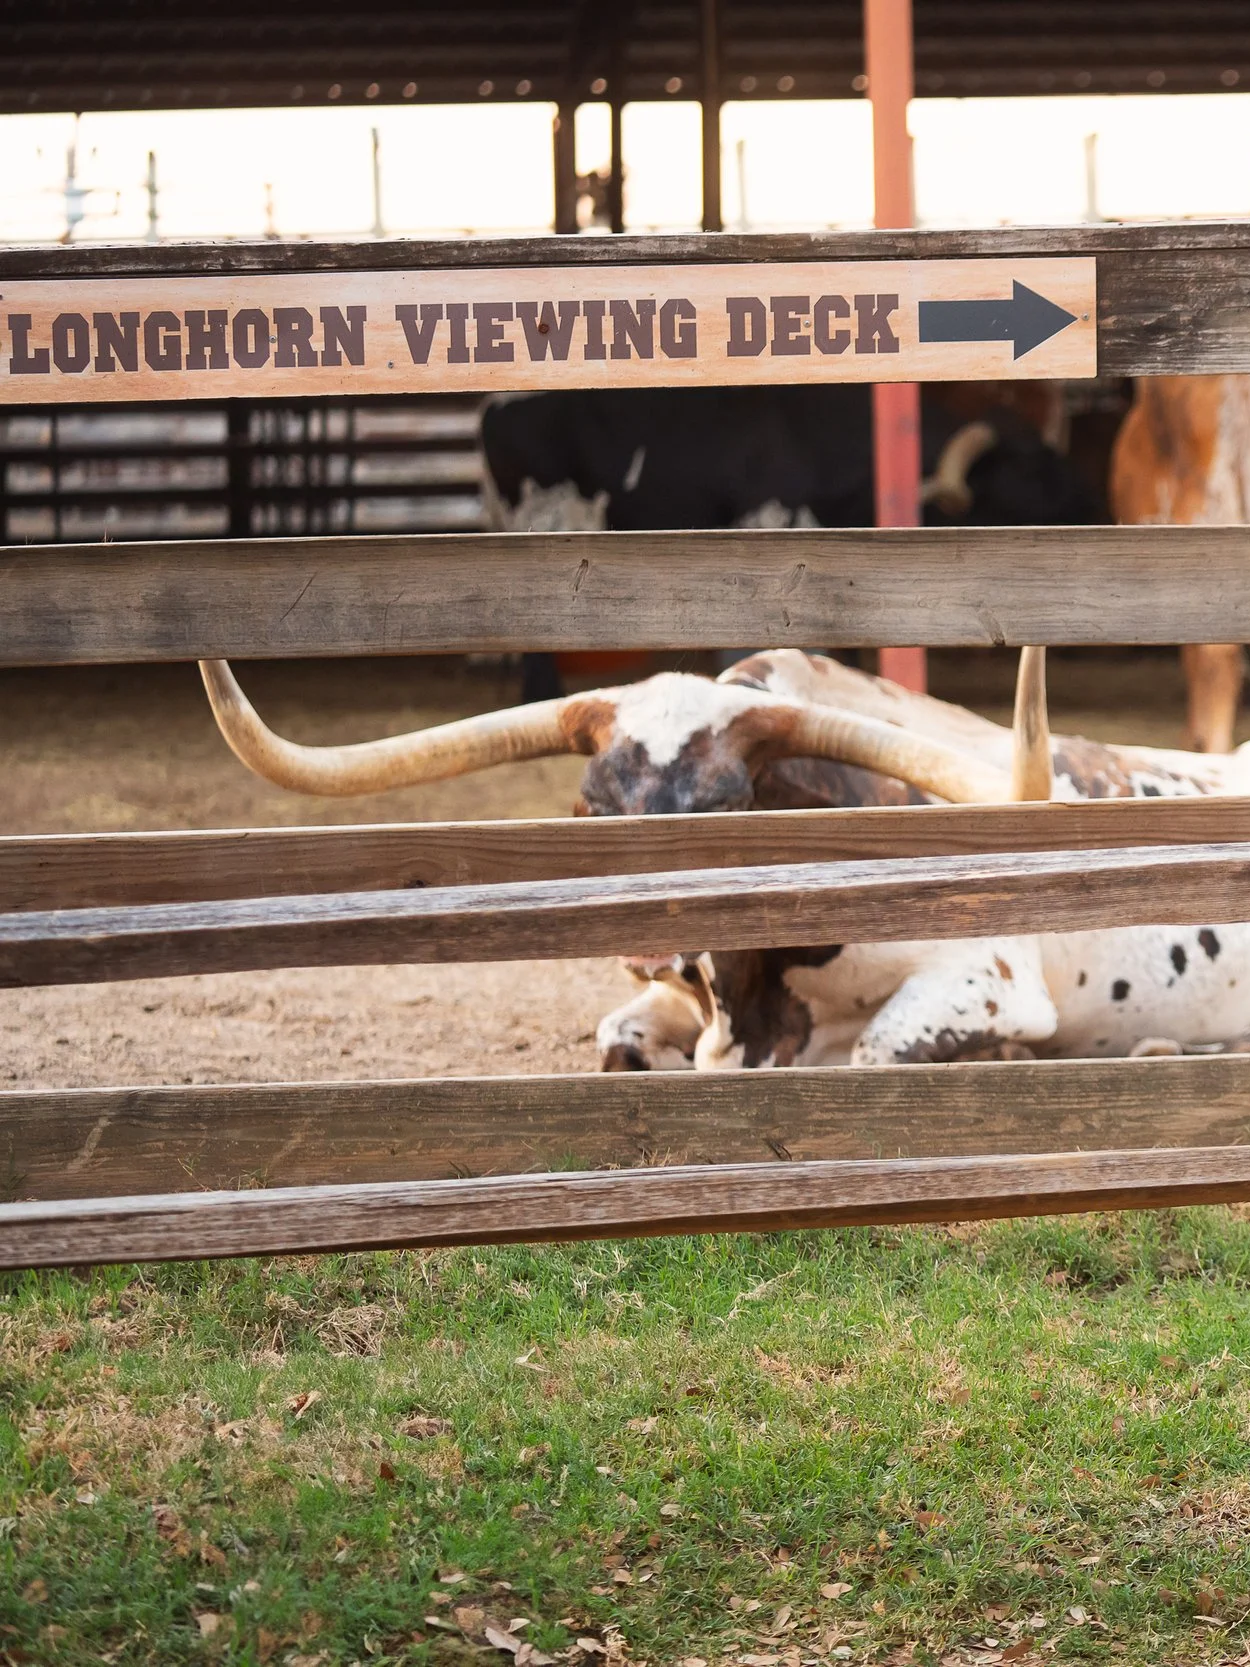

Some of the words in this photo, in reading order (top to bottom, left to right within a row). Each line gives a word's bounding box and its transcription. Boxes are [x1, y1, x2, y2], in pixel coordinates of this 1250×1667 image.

[8, 305, 367, 374] LONGHORN
[395, 298, 697, 364] VIEWING
[726, 294, 899, 357] DECK
